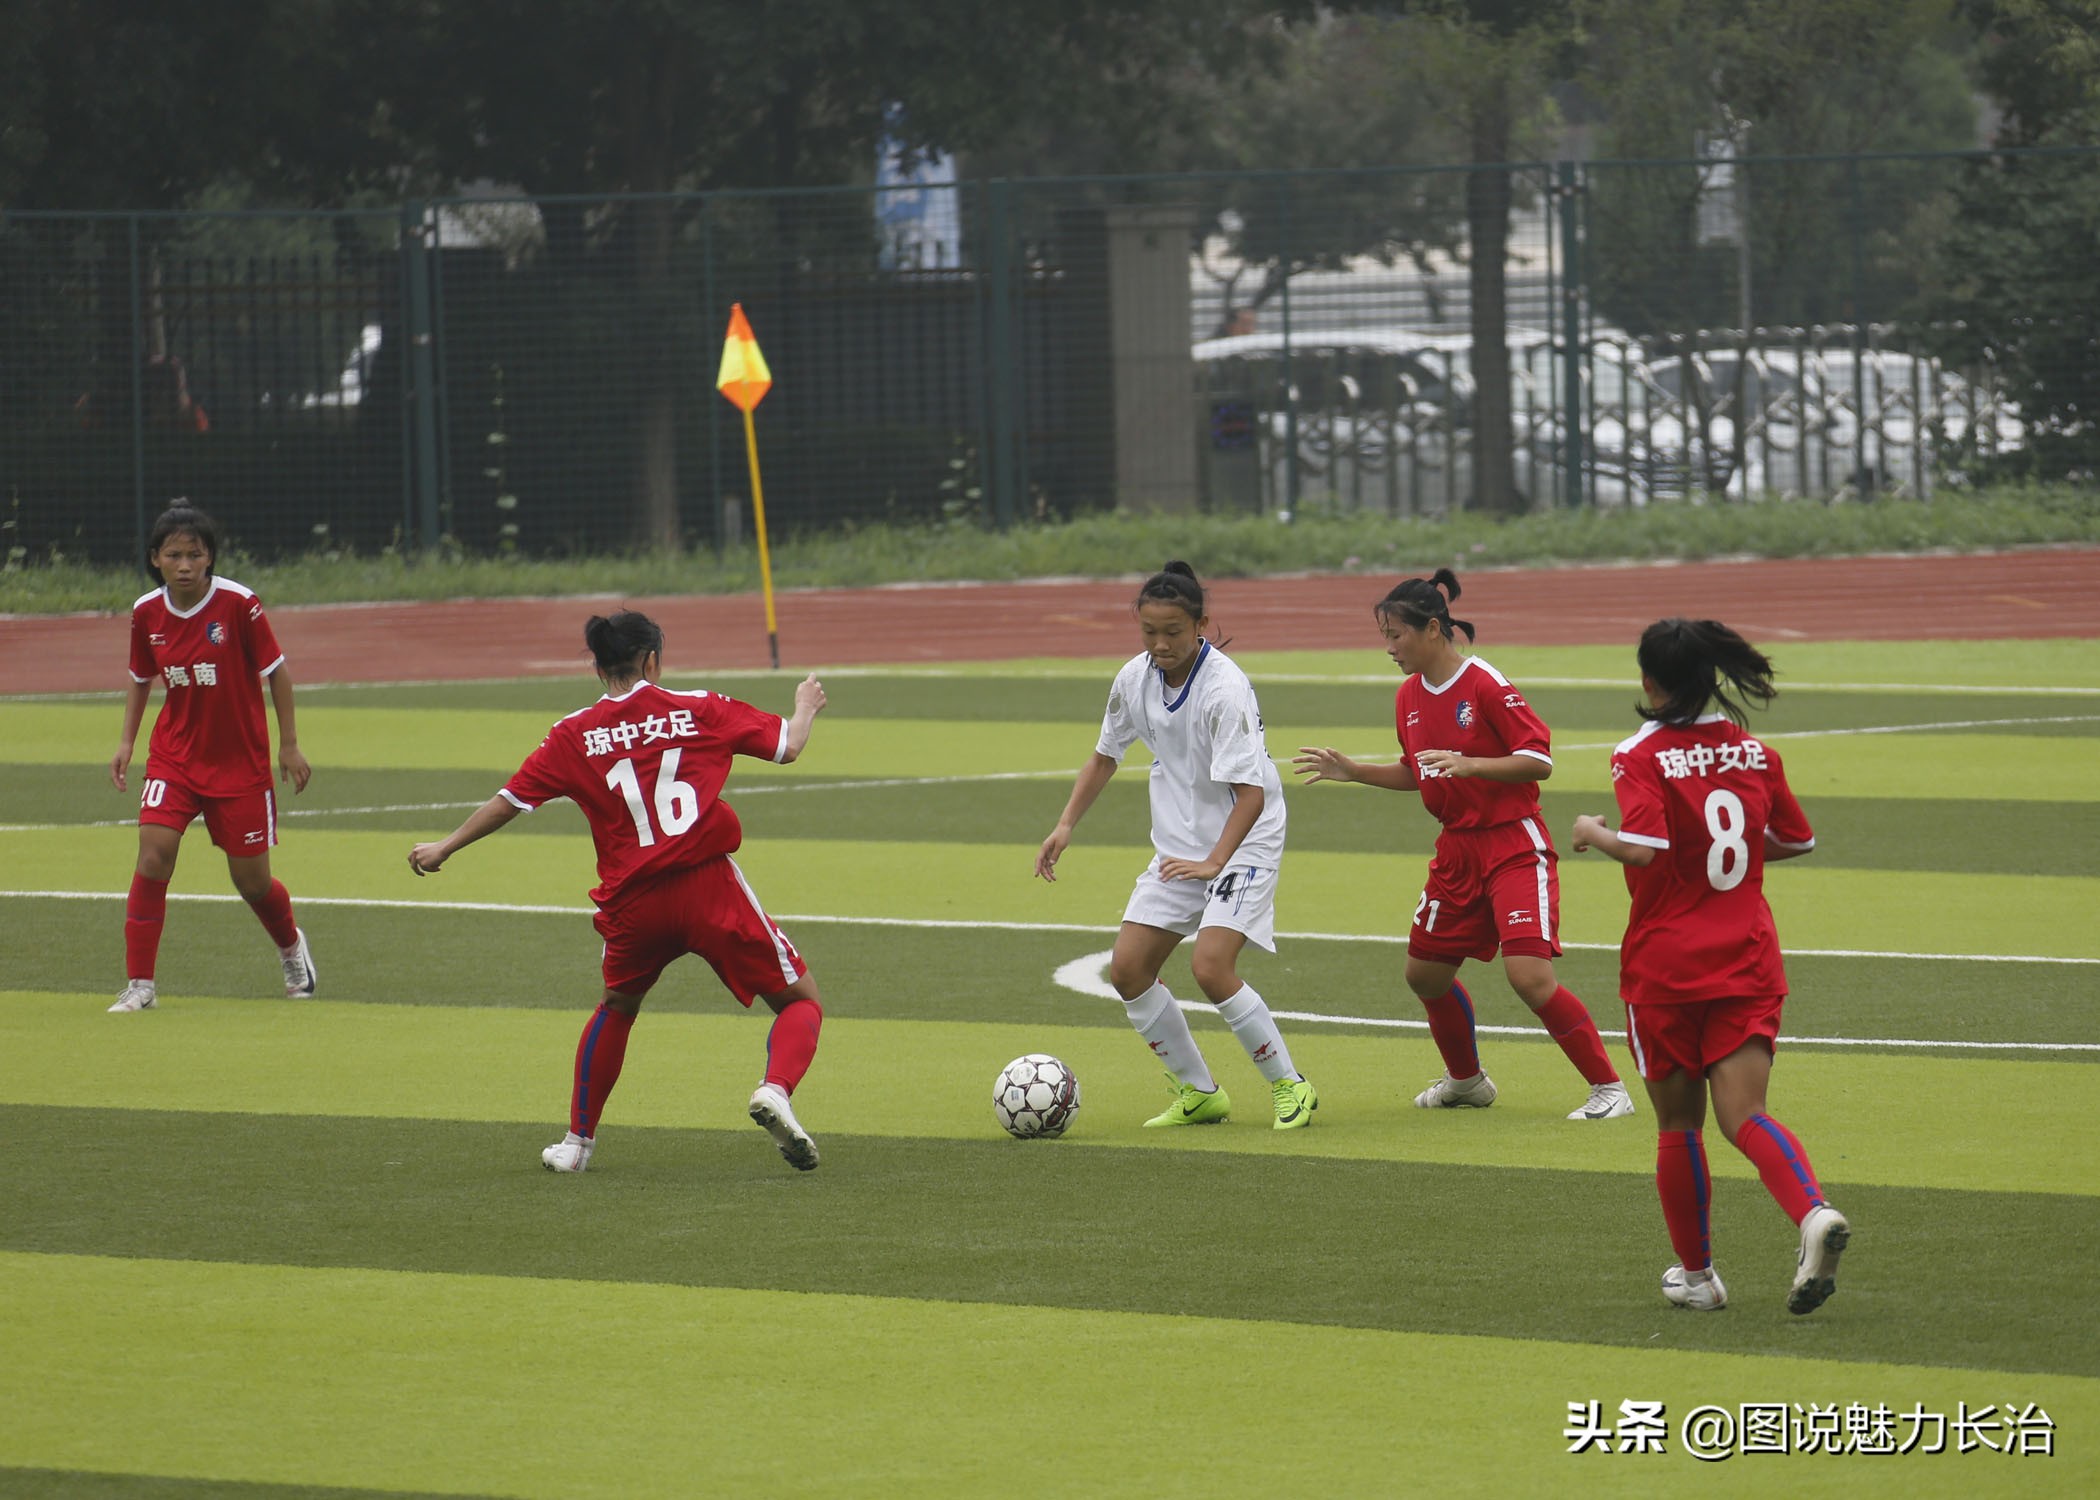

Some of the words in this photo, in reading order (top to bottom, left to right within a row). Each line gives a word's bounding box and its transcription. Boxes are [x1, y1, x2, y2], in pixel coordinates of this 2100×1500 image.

[164, 662, 217, 688] 海南
[582, 709, 699, 757] 琼中女足
[1655, 739, 1768, 779] 琼中女足
[605, 746, 699, 848] 16
[1704, 788, 1749, 891] 8
[1413, 890, 1440, 933] 21
